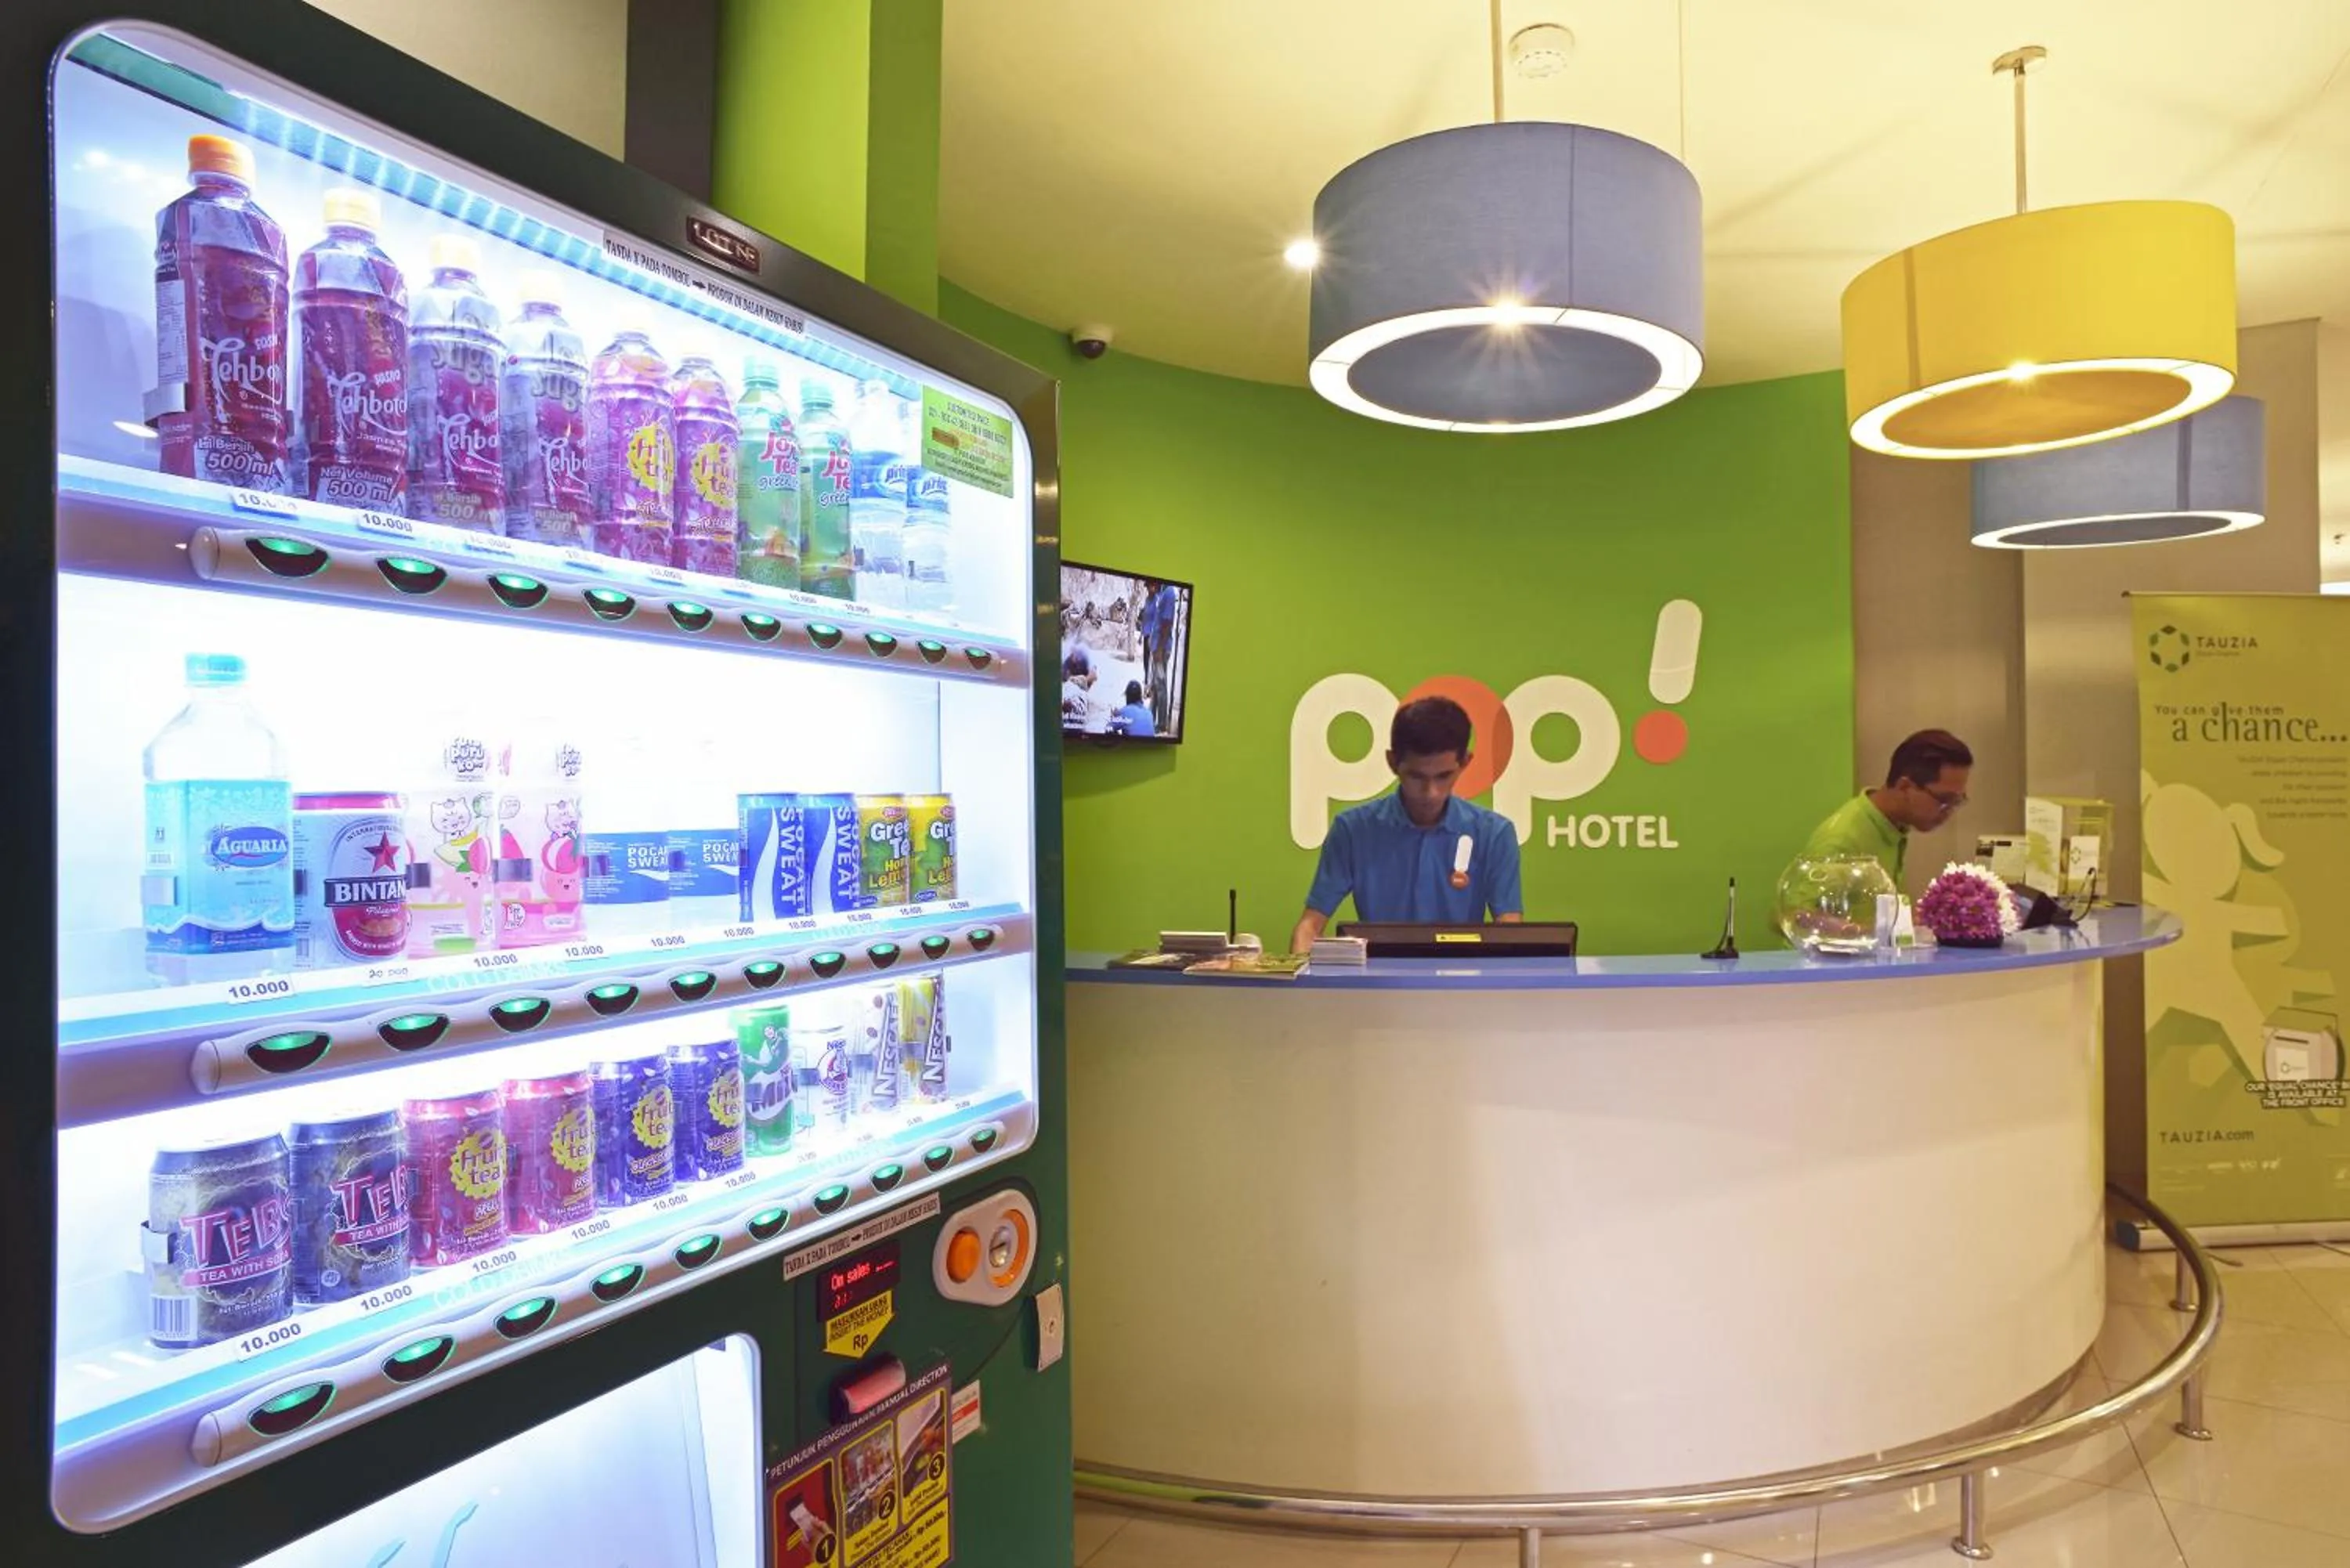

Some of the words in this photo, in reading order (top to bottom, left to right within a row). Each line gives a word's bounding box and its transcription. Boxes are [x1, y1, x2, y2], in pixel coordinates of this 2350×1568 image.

[208, 452, 248, 470] 500
[327, 481, 366, 497] 500
[2196, 636, 2259, 649] TAUZIA
[2248, 705, 2284, 715] them
[2172, 717, 2189, 742] a
[1547, 815, 1679, 849] HOTEL
[780, 807, 797, 905] SWEAT
[837, 805, 851, 900] SWEAT
[650, 936, 685, 947] 10.000
[565, 945, 603, 957] 10.000
[474, 953, 519, 969] 10.000
[229, 980, 289, 999] 10.000
[2160, 1130, 2254, 1143] TAUZIA.com
[470, 1165, 501, 1185] tea
[653, 1194, 689, 1211] 10.000
[352, 1230, 373, 1241] TEA
[571, 1219, 610, 1240] 10.000
[201, 1270, 226, 1282] TEA
[231, 1260, 263, 1277] WITH
[472, 1252, 517, 1273] 10.000
[831, 1274, 844, 1291] On
[360, 1284, 413, 1310] 10.000
[240, 1323, 302, 1353] 10.000
[852, 1334, 868, 1351] Rp
